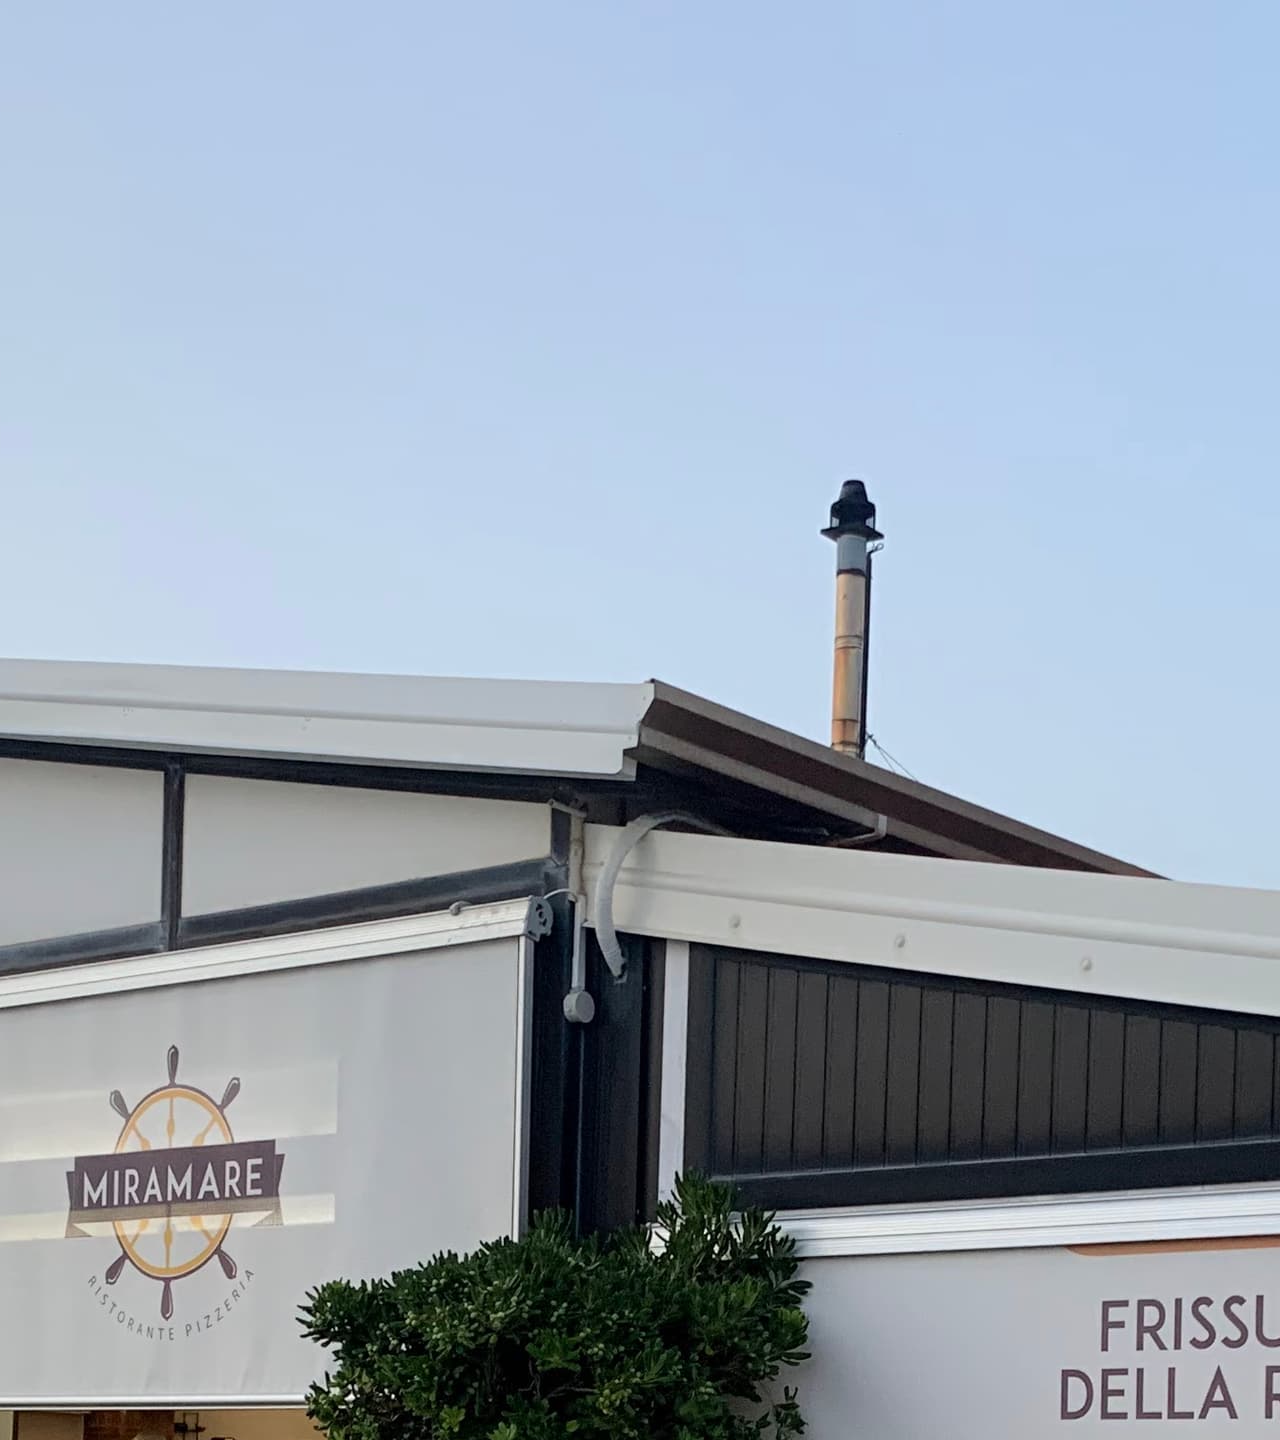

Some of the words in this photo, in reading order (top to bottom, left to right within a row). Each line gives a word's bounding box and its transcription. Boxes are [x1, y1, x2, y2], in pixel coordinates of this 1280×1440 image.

[82, 1157, 264, 1208] MIRAMARE
[87, 1275, 175, 1341] RISTORANTE
[185, 1269, 255, 1337] PIZZERIA
[1059, 1364, 1239, 1421] DELLA
